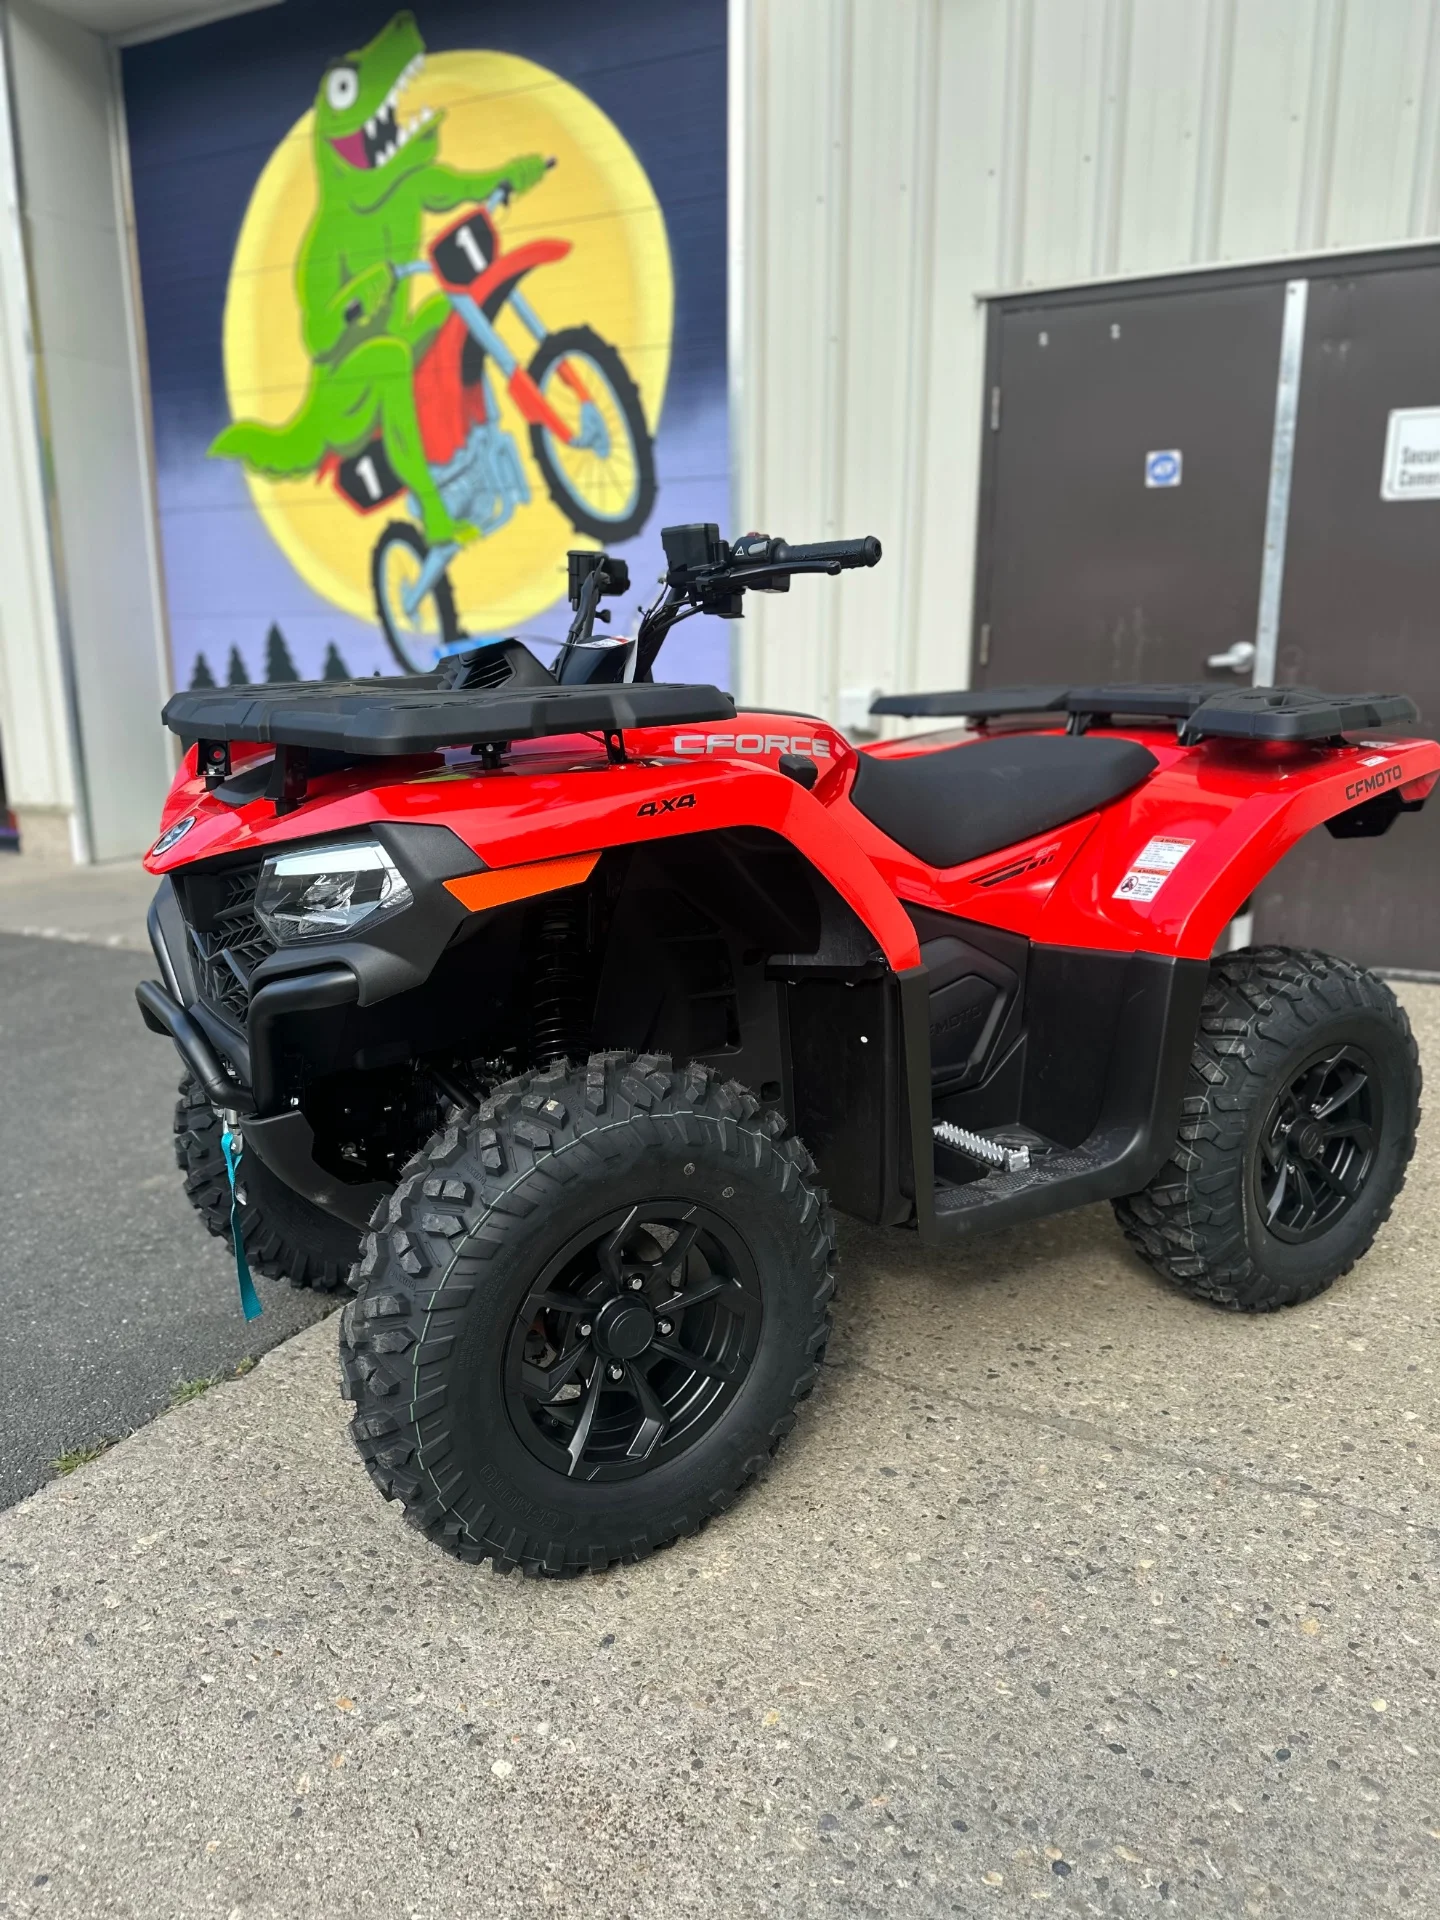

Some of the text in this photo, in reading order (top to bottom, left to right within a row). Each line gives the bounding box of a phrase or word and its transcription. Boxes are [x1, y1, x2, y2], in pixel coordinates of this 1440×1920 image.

[455, 225, 488, 273] 1
[355, 456, 383, 500] 1
[674, 734, 831, 758] CFORCE
[1345, 765, 1402, 801] CFMOTO
